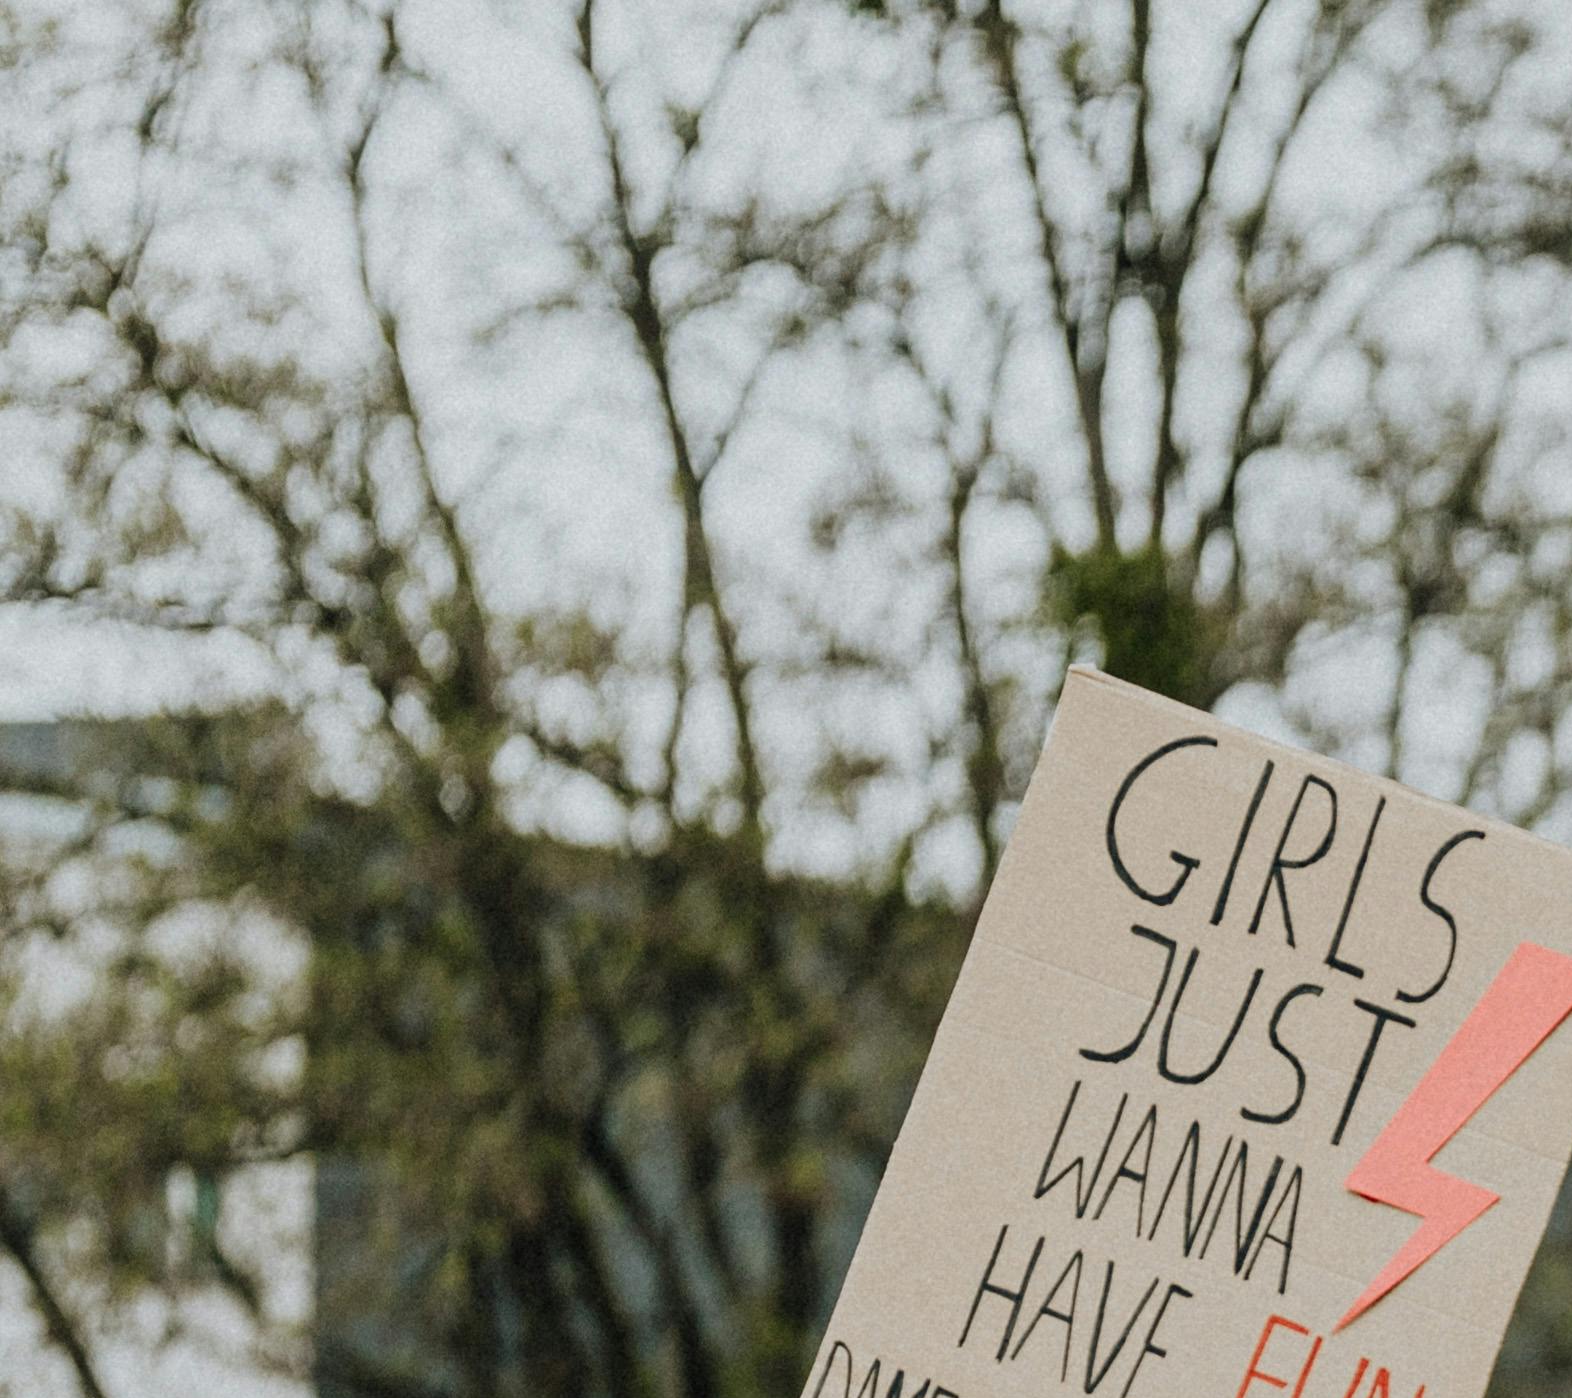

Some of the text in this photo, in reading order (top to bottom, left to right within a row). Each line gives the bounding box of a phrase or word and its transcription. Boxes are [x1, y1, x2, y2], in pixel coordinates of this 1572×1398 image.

[1105, 735, 1486, 1005] GIRLS
[1078, 923, 1417, 1146] JUST
[1033, 1080, 1303, 1295] WANNA
